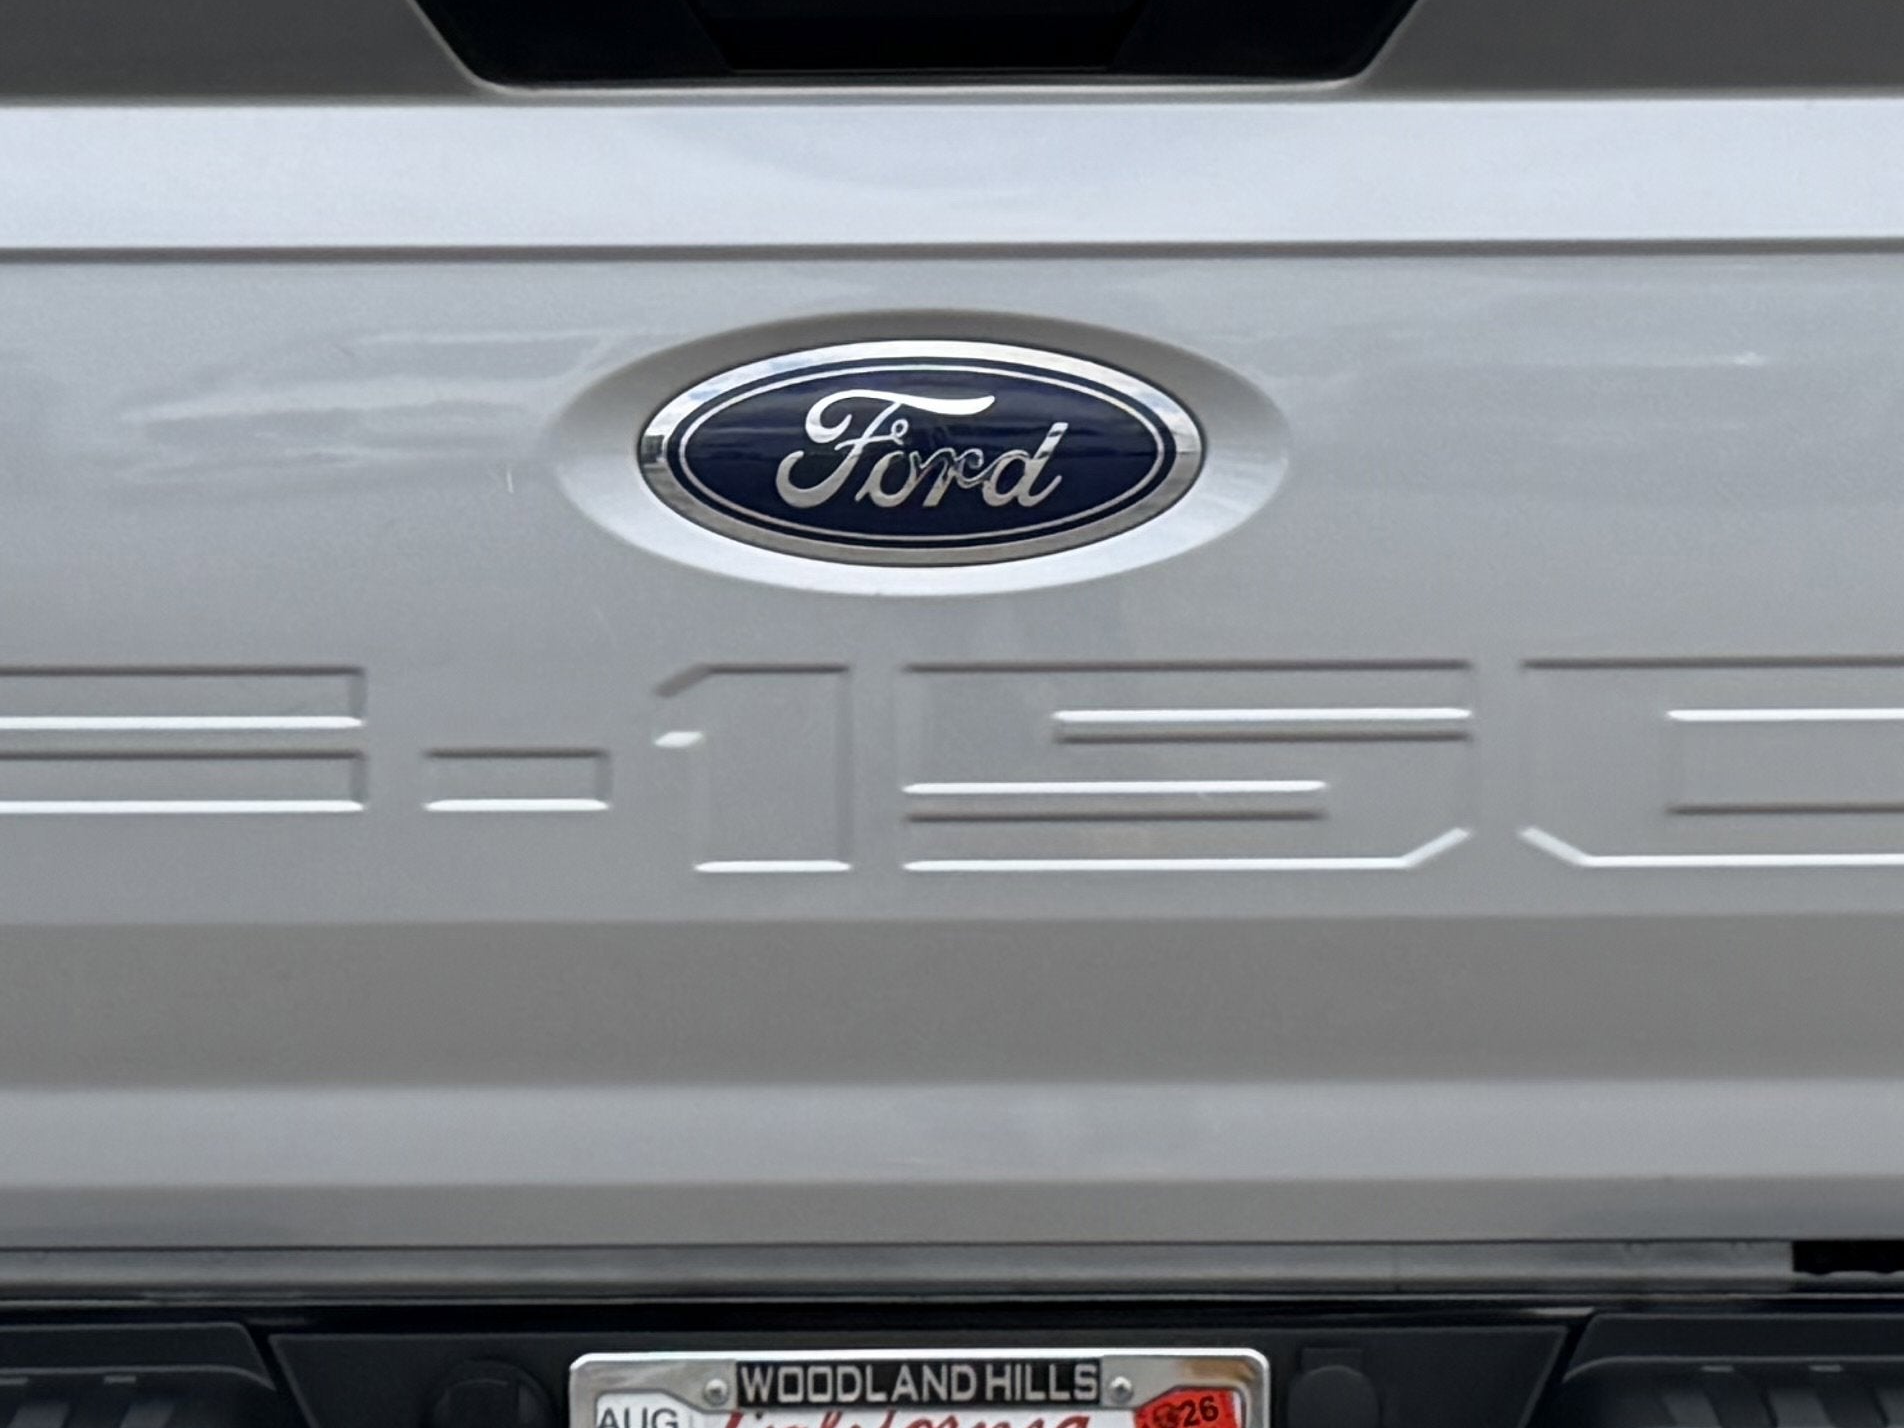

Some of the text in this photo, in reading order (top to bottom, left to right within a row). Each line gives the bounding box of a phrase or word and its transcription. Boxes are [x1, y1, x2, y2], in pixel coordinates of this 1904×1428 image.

[774, 388, 1069, 509] Ford
[740, 1362, 1100, 1404] WOODLAND HILLS
[1177, 1395, 1220, 1428] 26
